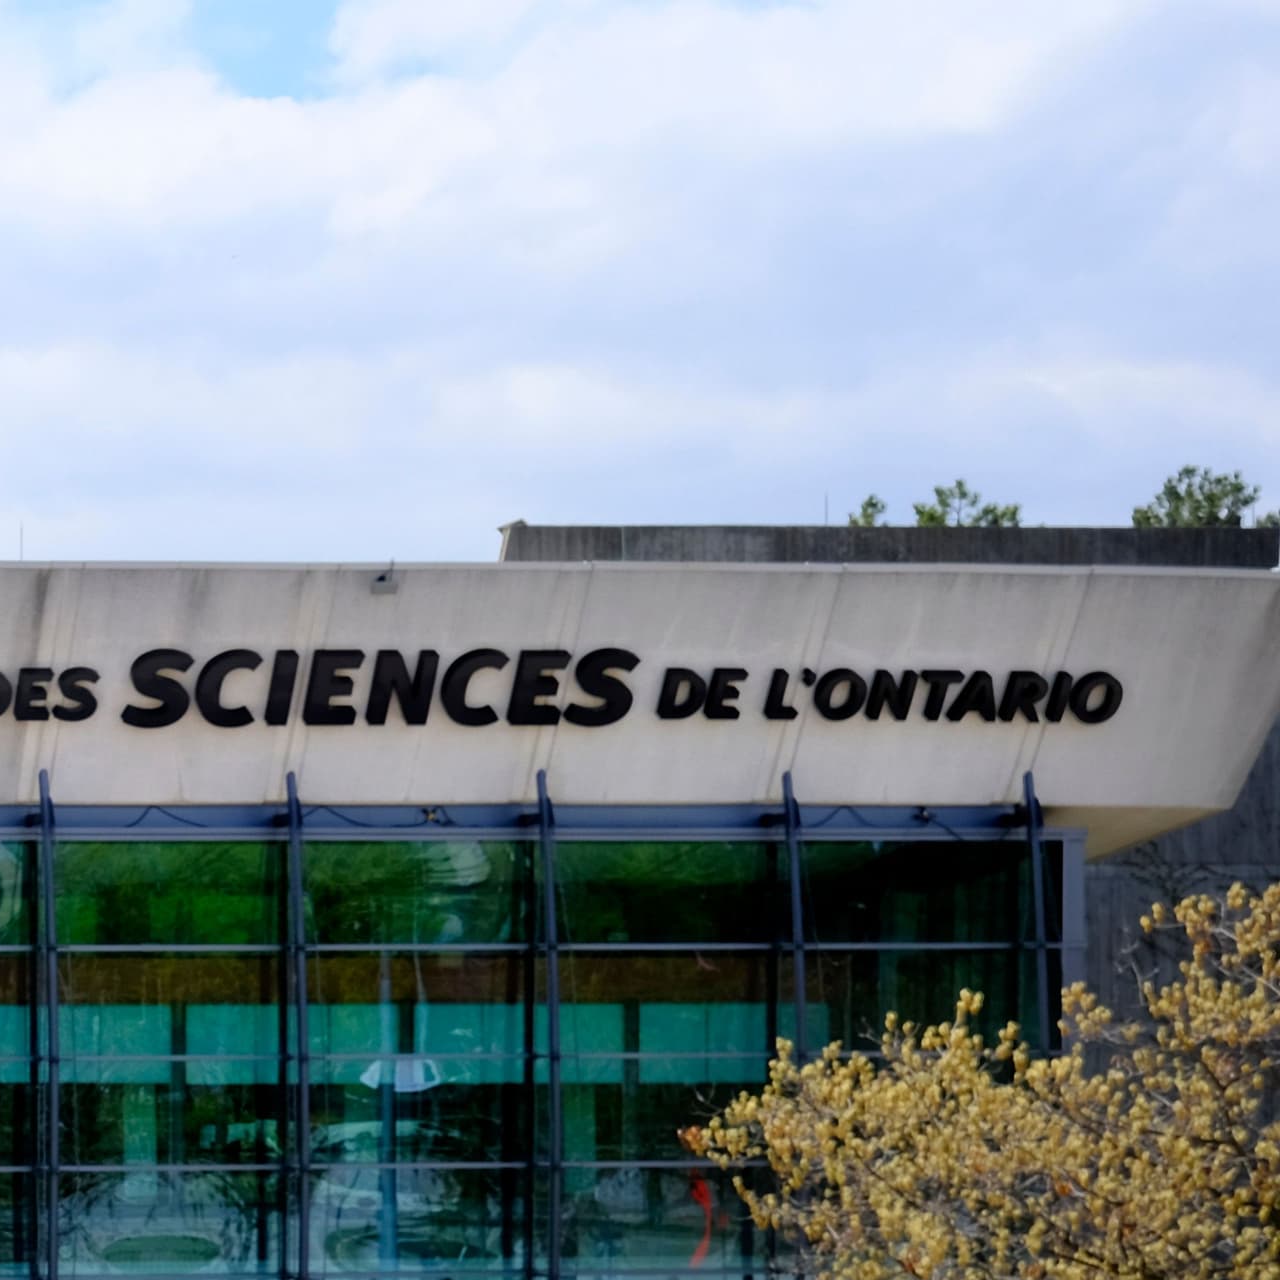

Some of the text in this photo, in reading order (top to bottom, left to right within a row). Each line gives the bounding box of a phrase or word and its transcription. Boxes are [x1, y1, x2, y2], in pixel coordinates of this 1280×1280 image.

[120, 647, 642, 729] SCIENCES
[654, 667, 750, 721] DE
[761, 667, 1125, 726] L'ONTARIO
